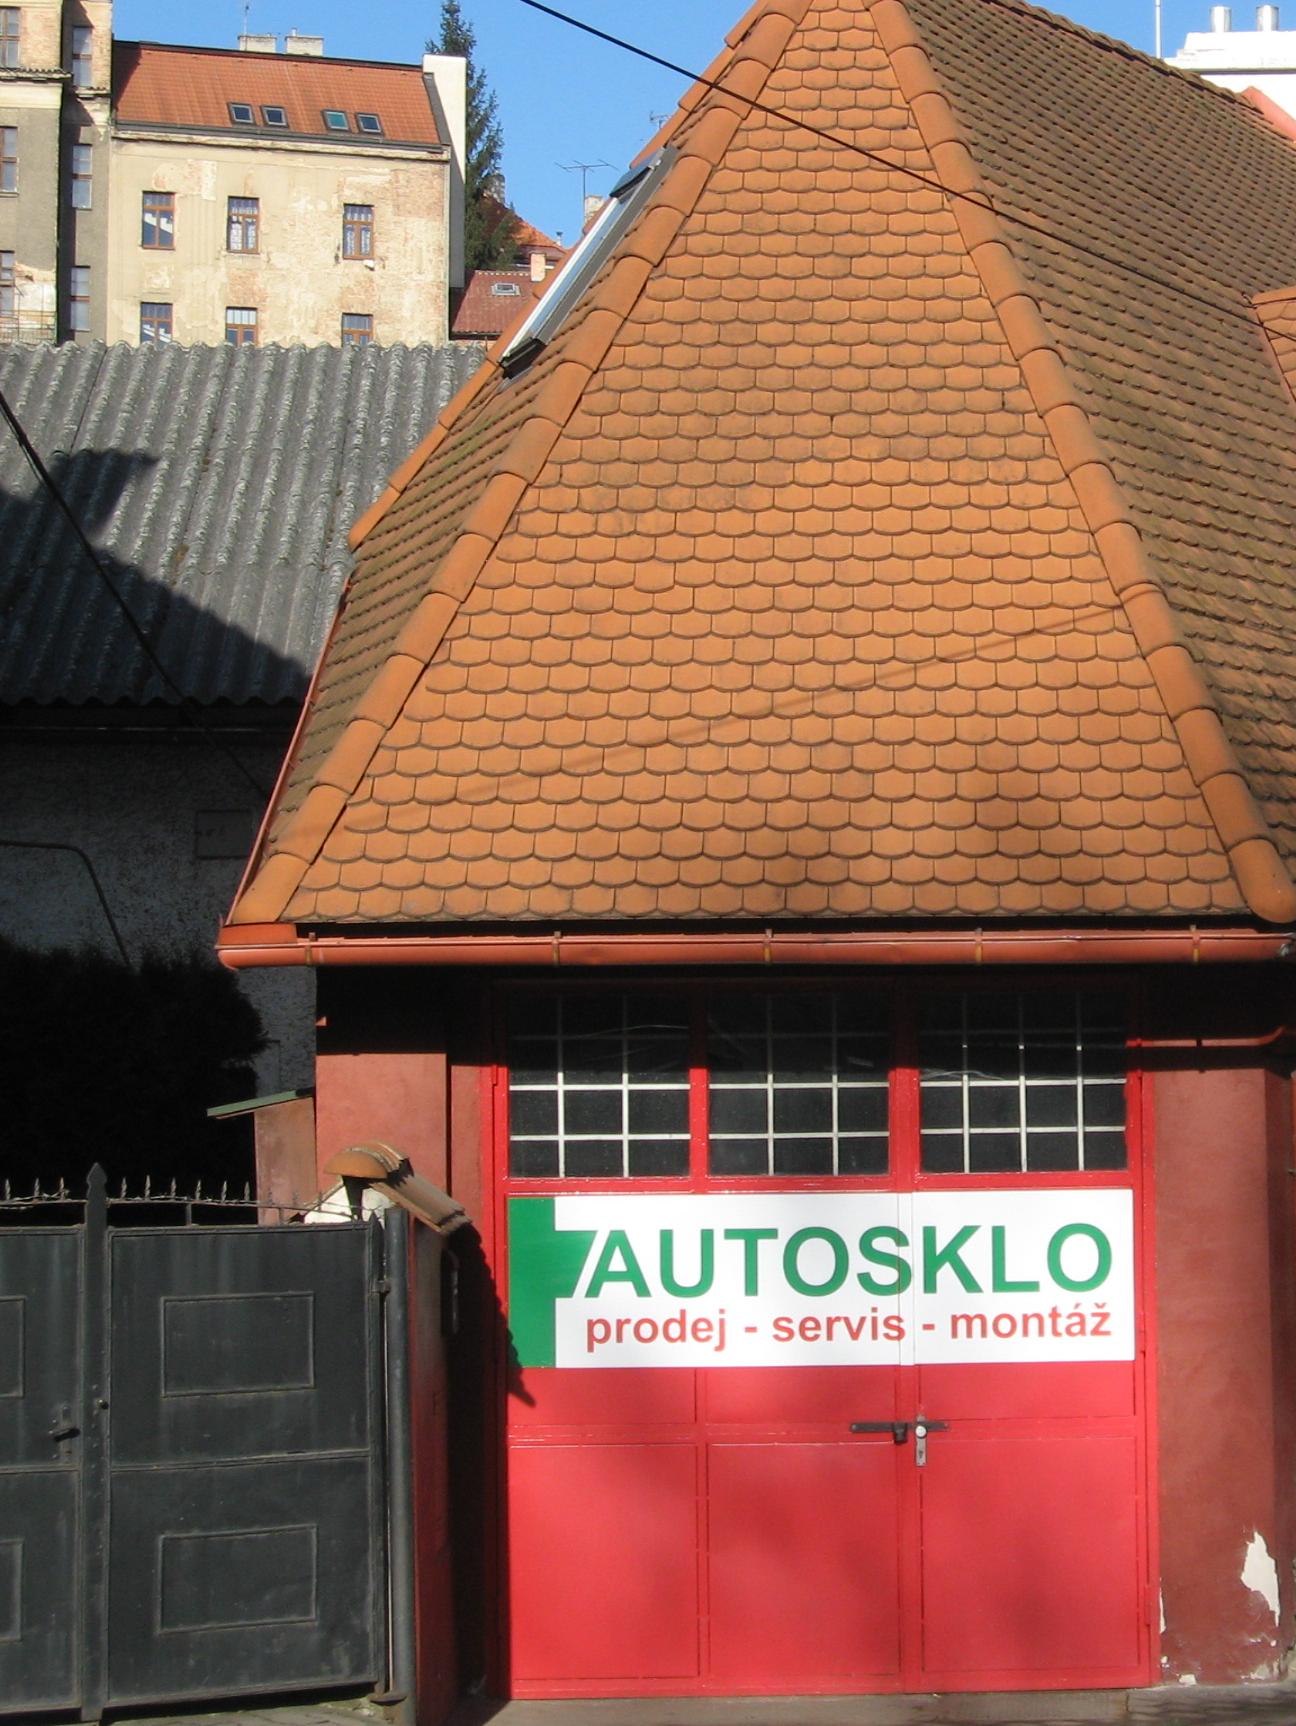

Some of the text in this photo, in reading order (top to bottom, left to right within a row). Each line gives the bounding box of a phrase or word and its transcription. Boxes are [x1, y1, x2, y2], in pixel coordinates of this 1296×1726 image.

[584, 1222, 1113, 1299] AUTOSKLO
[585, 1307, 728, 1353] prodej
[771, 1308, 907, 1342] servis
[949, 1302, 1113, 1339] montáž
